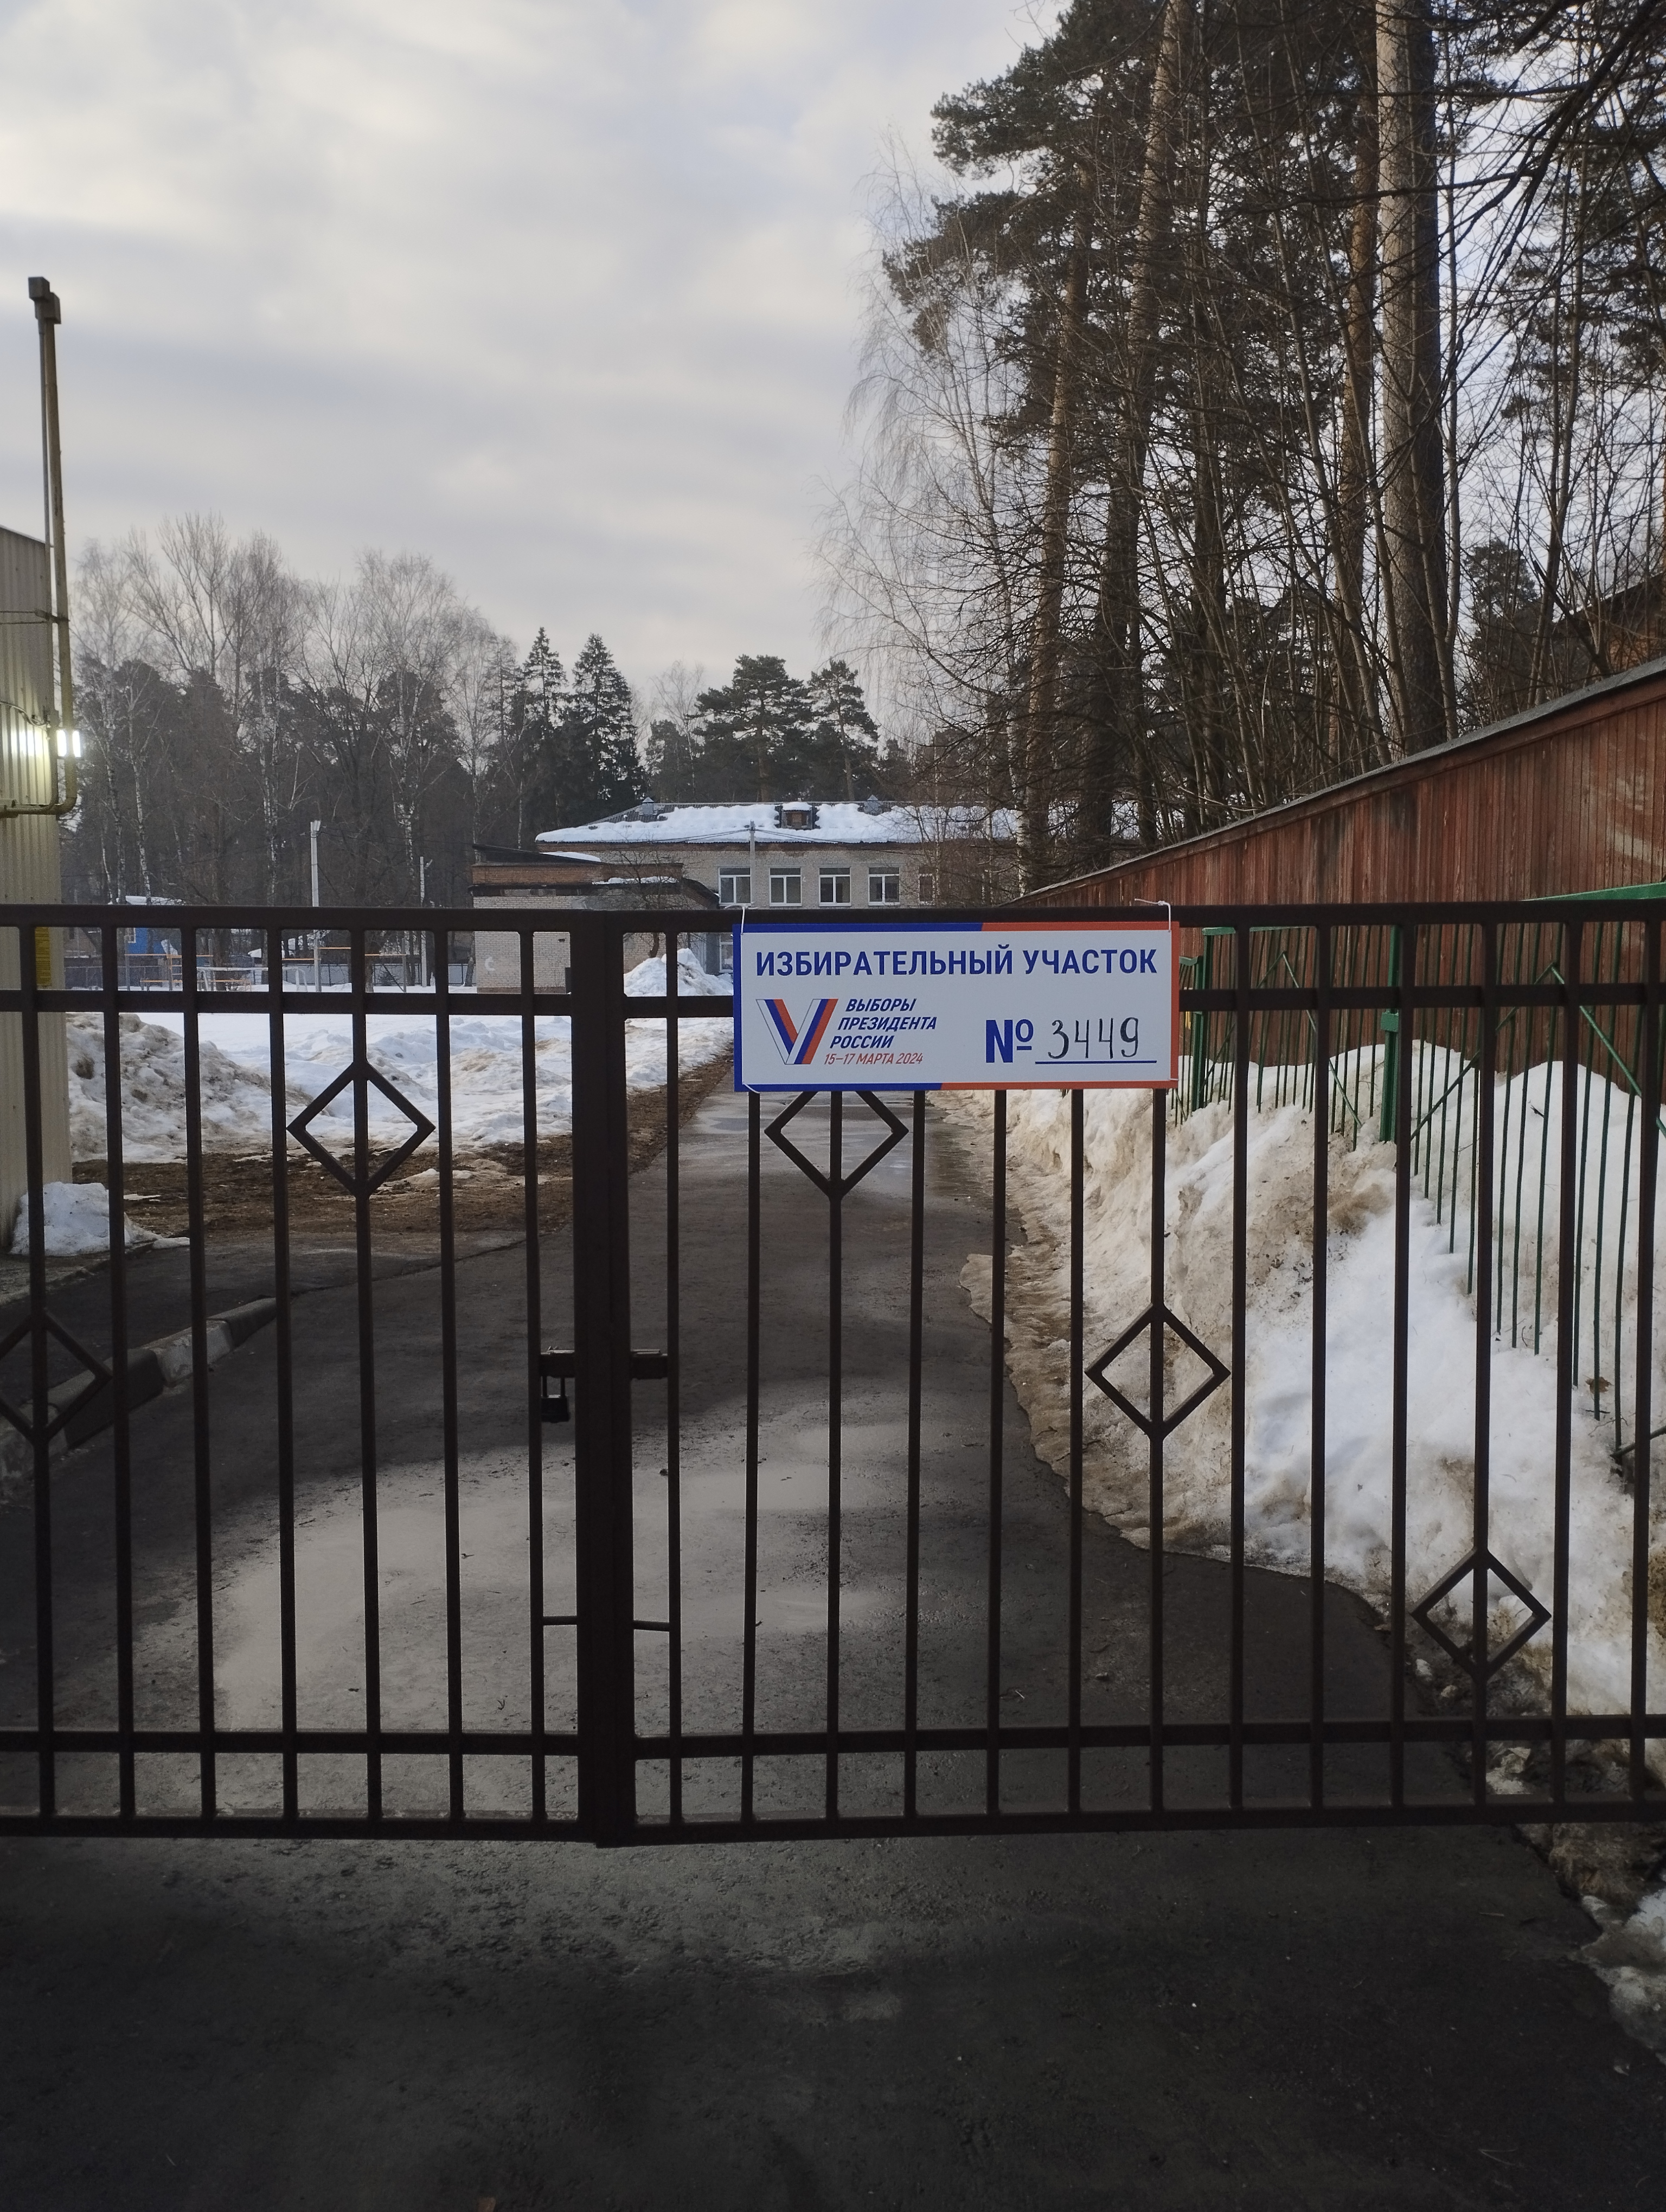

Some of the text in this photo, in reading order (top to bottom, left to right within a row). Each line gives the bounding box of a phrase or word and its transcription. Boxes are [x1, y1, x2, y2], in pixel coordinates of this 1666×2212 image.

[756, 944, 1157, 976] ИЗБИРАТЕЛЬНЫЙ УЧАСТОК
[845, 998, 917, 1012] ВЫБОРЫ
[838, 1017, 937, 1032] ПРЕЗИДЕНТА
[830, 1035, 895, 1049] РОССИИ
[1047, 1017, 1139, 1059] 3449
[856, 1053, 893, 1065] МАРТА
[895, 1053, 924, 1065] 2024
